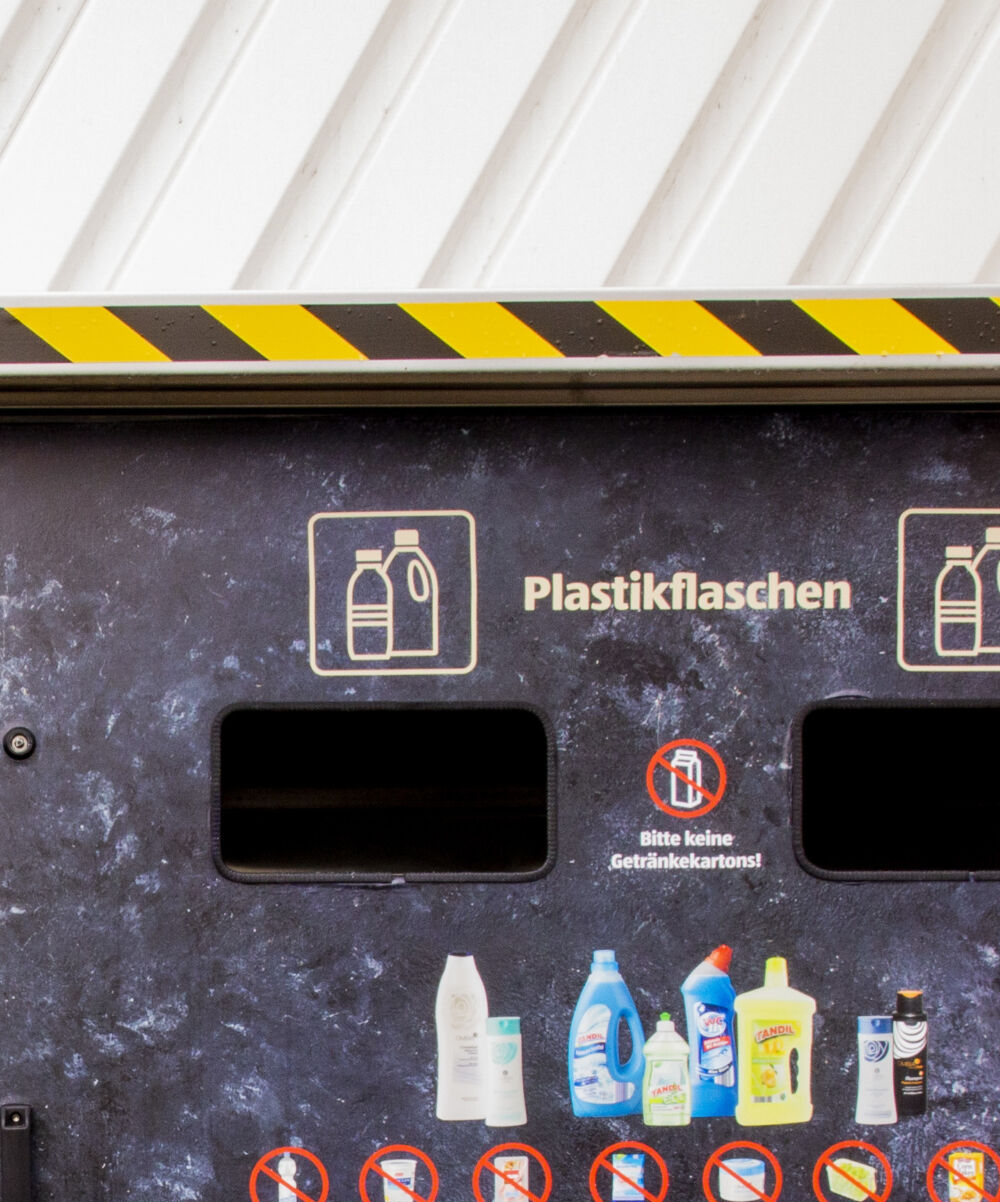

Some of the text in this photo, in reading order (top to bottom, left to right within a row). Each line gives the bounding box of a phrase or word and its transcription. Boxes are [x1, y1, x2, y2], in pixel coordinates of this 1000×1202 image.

[524, 571, 852, 613] Plastikflaschen
[640, 829, 734, 846] Bitte keine
[611, 852, 762, 870] Getränkekartons!
[755, 1024, 795, 1043] TANDIL
